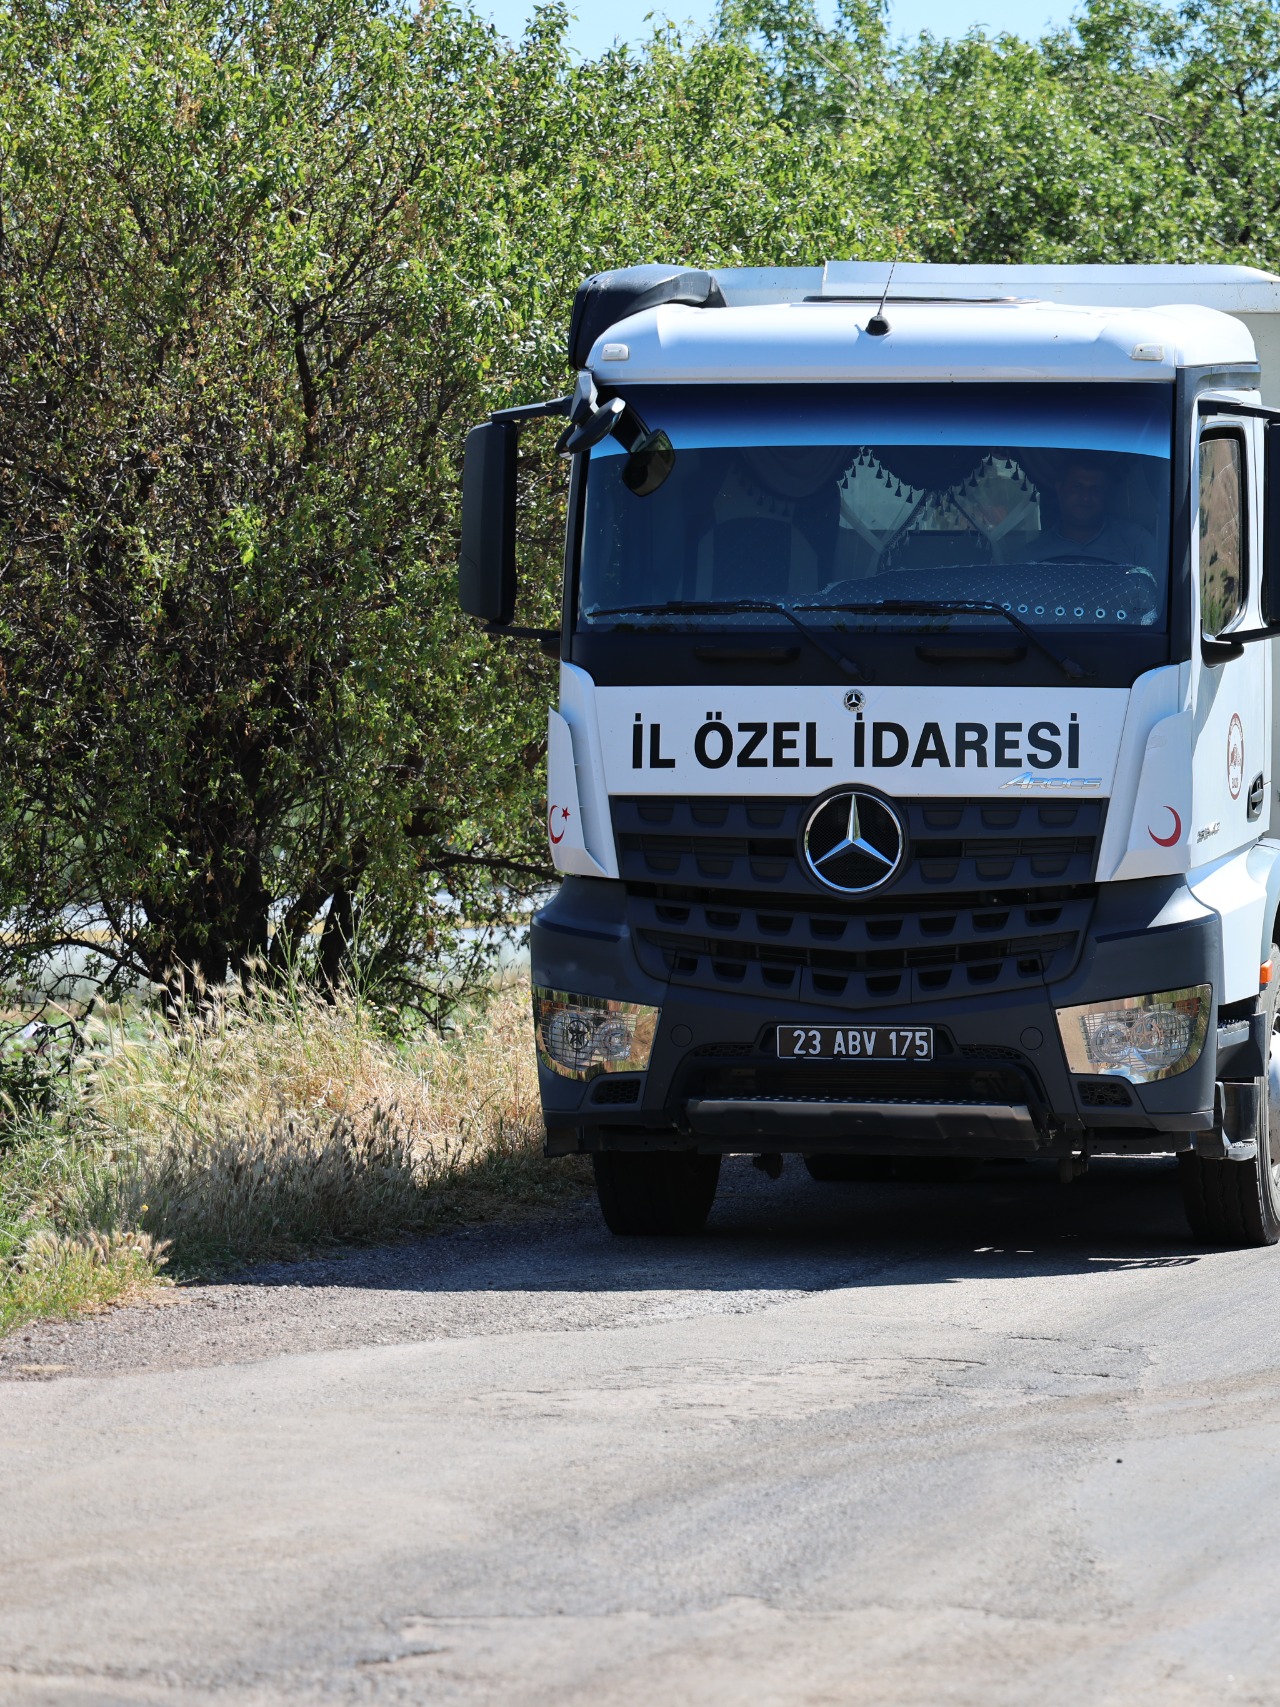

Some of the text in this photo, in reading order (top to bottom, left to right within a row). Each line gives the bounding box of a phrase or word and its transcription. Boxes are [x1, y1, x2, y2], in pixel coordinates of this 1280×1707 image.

[632, 711, 1080, 770] İL ÖZEL İDARESİ
[792, 1029, 929, 1057] 23 ABV 175
